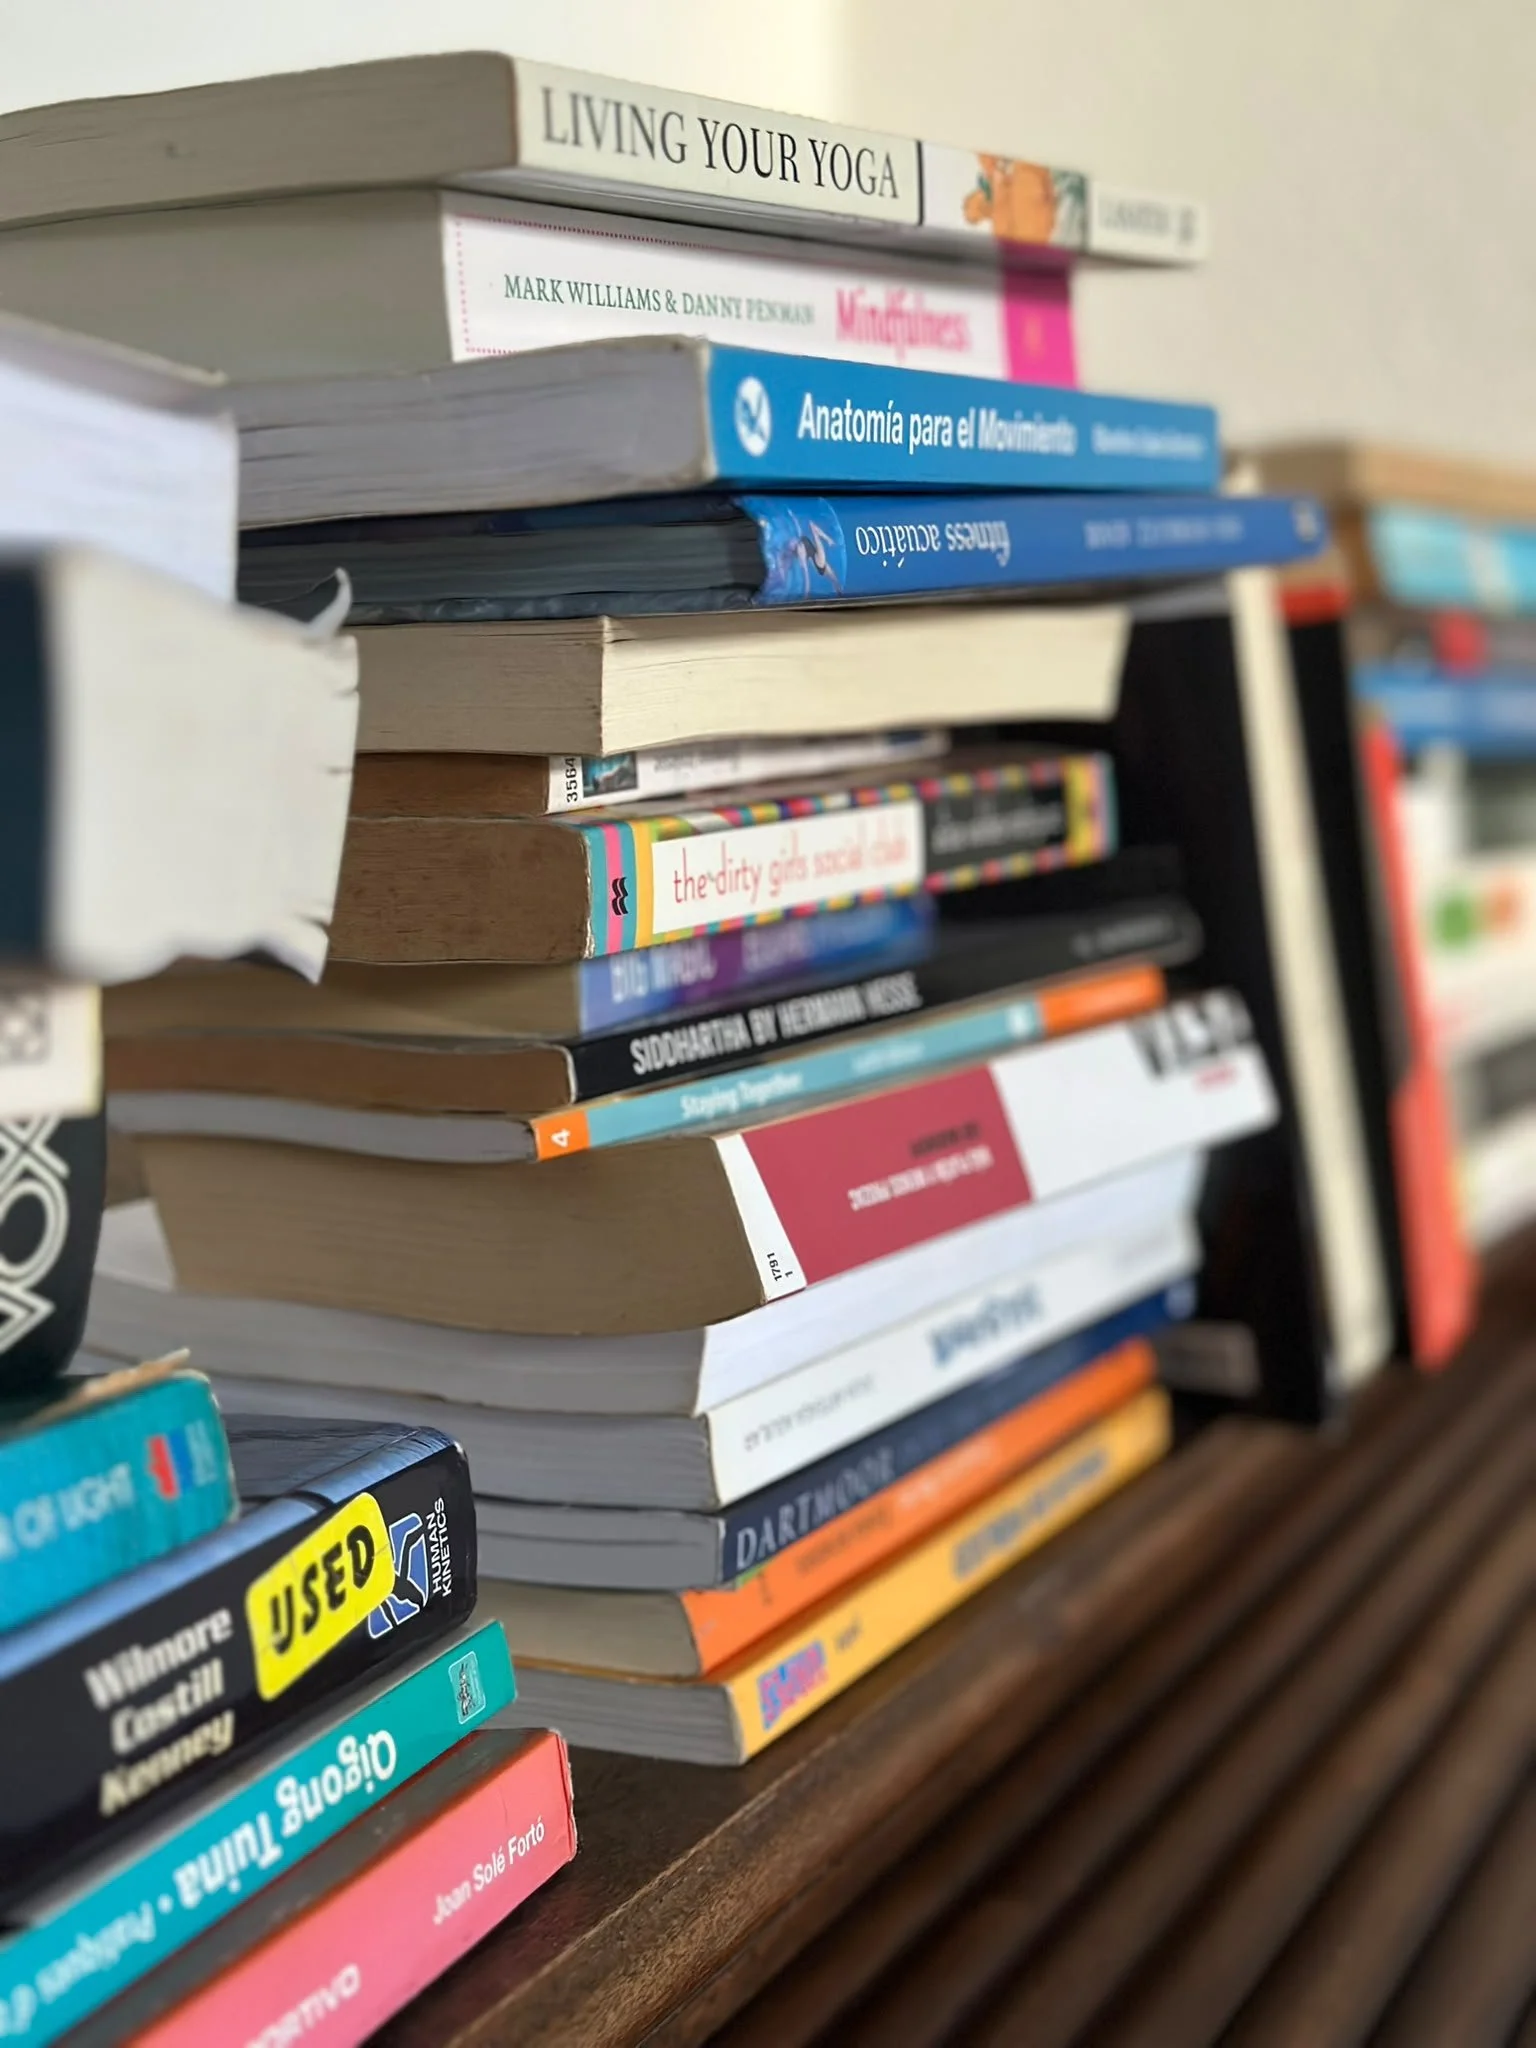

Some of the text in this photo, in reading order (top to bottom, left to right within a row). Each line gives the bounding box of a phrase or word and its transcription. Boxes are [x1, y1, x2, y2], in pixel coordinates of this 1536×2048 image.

[541, 87, 900, 199] LIVING YOUR YOGA
[504, 274, 815, 325] MARK WILLIAMS & DANNY PENMAN
[797, 392, 904, 446] Anatomía
[909, 412, 952, 455] para
[957, 407, 976, 449] el
[978, 406, 1078, 457] Movimiento
[856, 521, 1011, 568] fitness acuático
[566, 757, 578, 802] 3564
[714, 839, 762, 904] dirty
[769, 827, 808, 897] girls
[630, 1013, 752, 1075] SIDDHARTHA
[749, 1006, 778, 1046] BY
[680, 1071, 802, 1119] Staying Together
[552, 1129, 571, 1148] 4
[766, 1252, 782, 1282] 1791
[13, 1492, 57, 1550] OF
[57, 1461, 136, 1531] LIGHT
[434, 1497, 452, 1597] KINETICS
[269, 1524, 376, 1656] USED
[426, 1512, 442, 1594] HUMAN
[84, 1607, 233, 1711] Wilmore
[111, 1655, 225, 1756] Costill
[98, 1708, 235, 1818] Kenney
[275, 1729, 397, 1838] Qigong
[172, 1811, 284, 1910] Tuina
[433, 1814, 545, 1926] Joan Solé Fortó
